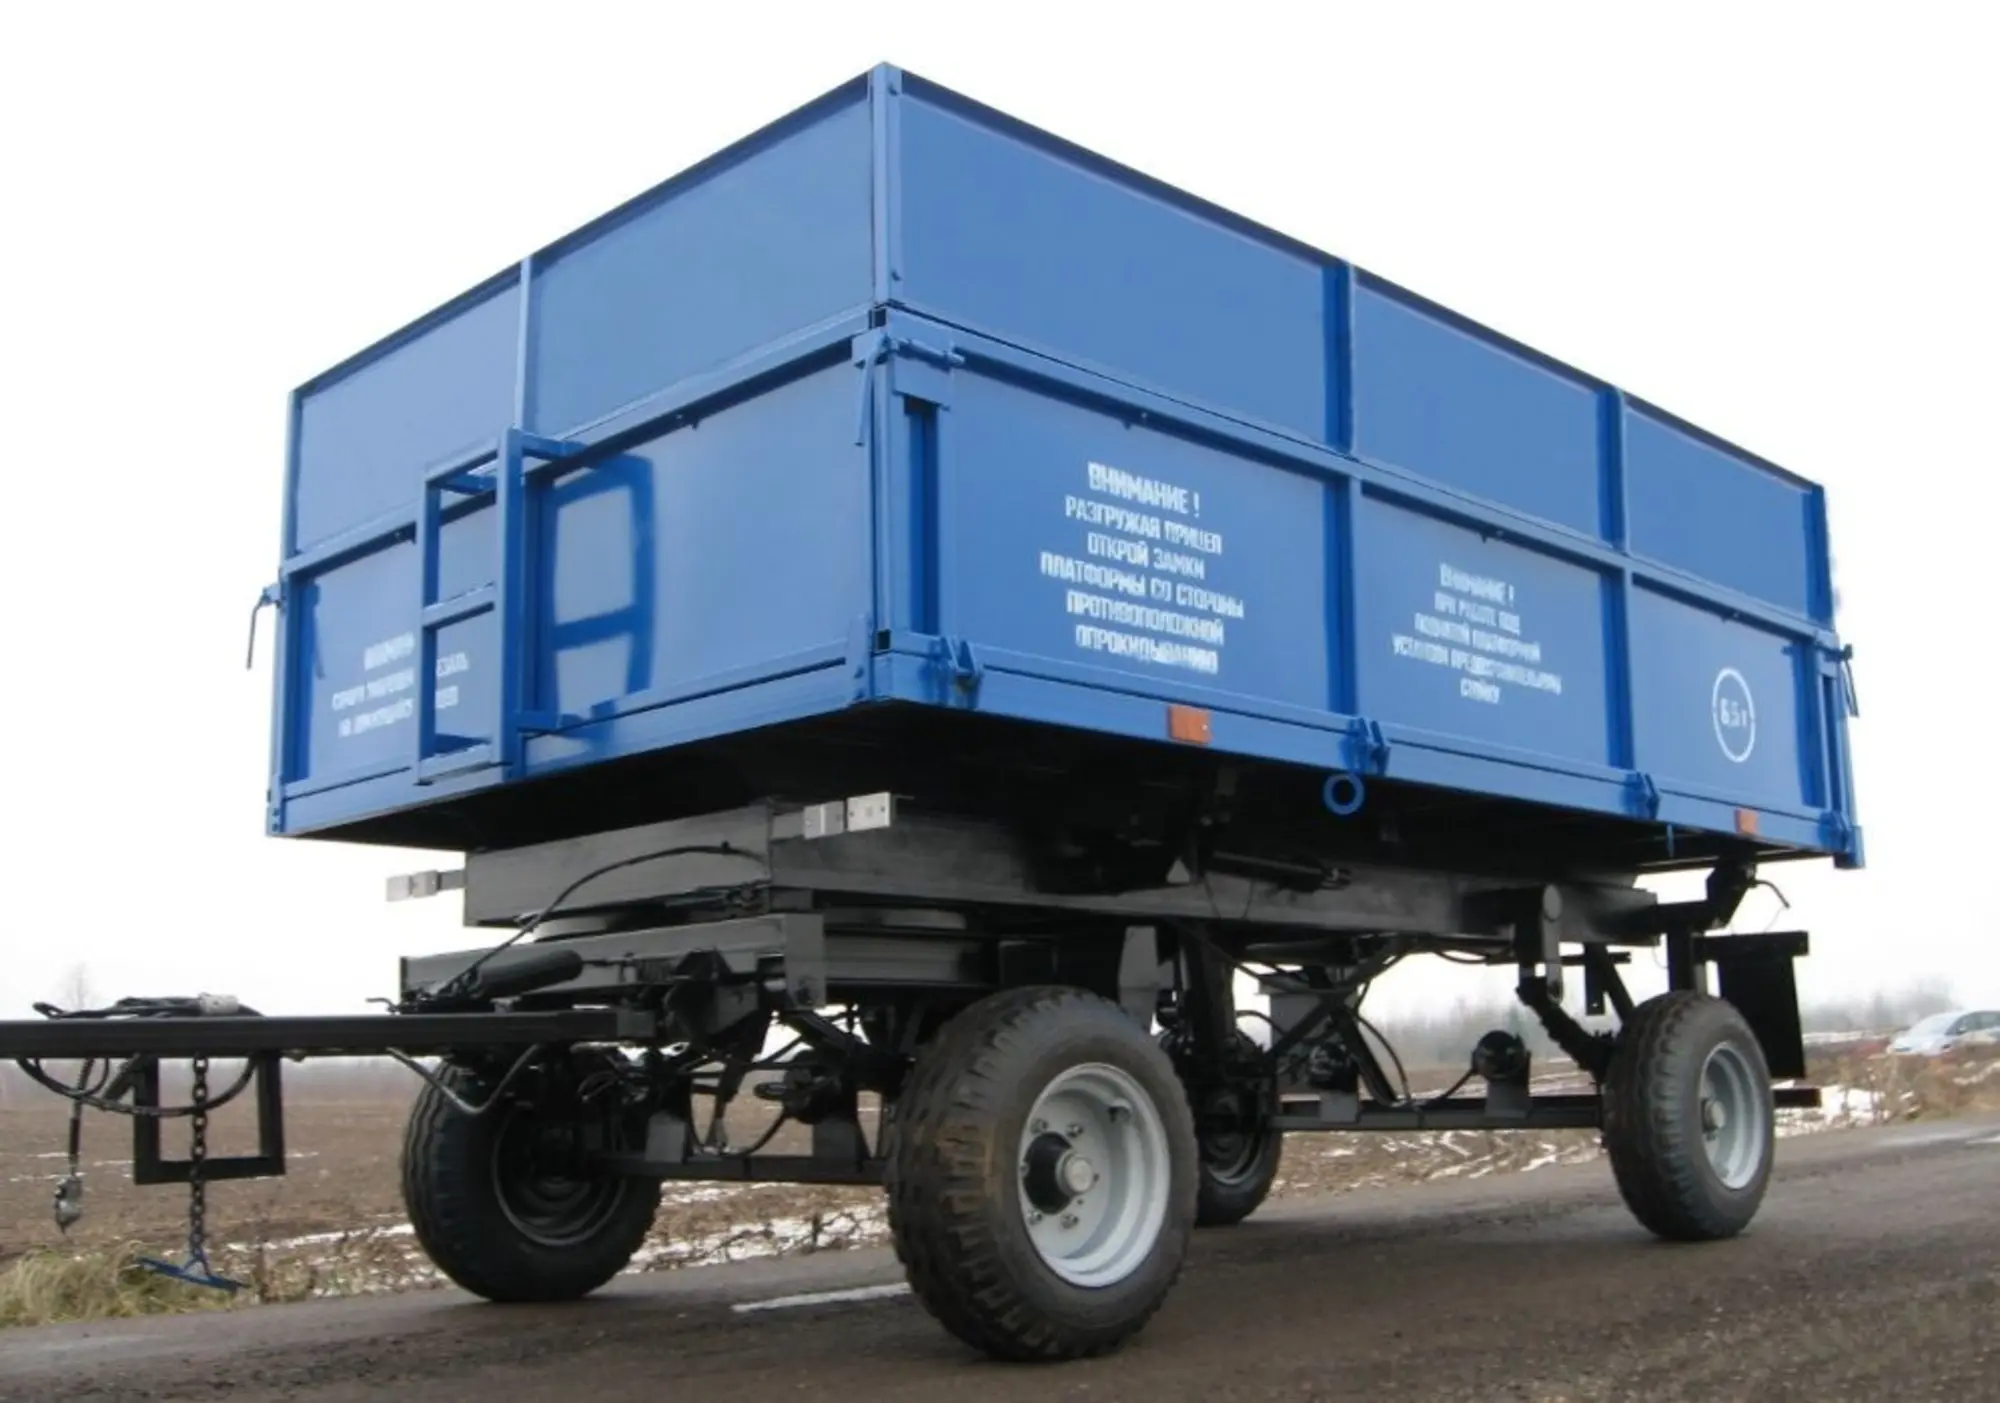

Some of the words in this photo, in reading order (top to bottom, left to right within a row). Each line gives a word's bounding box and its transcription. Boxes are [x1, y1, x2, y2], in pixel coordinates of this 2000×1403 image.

[1088, 461, 1189, 515] ВНИМАНИЕ
[1193, 492, 1200, 518] !
[1065, 495, 1161, 539] РАЗГРУЖАЯ
[1164, 519, 1222, 556] ПРИЦЕП
[1040, 551, 1145, 597] ПЛАТФОРМЫ
[1150, 577, 1172, 602] СО
[1176, 583, 1244, 619] СТОРОНЫ
[1088, 531, 1149, 568] ОТКРОЙ
[1153, 548, 1205, 580] ЗАМКИ
